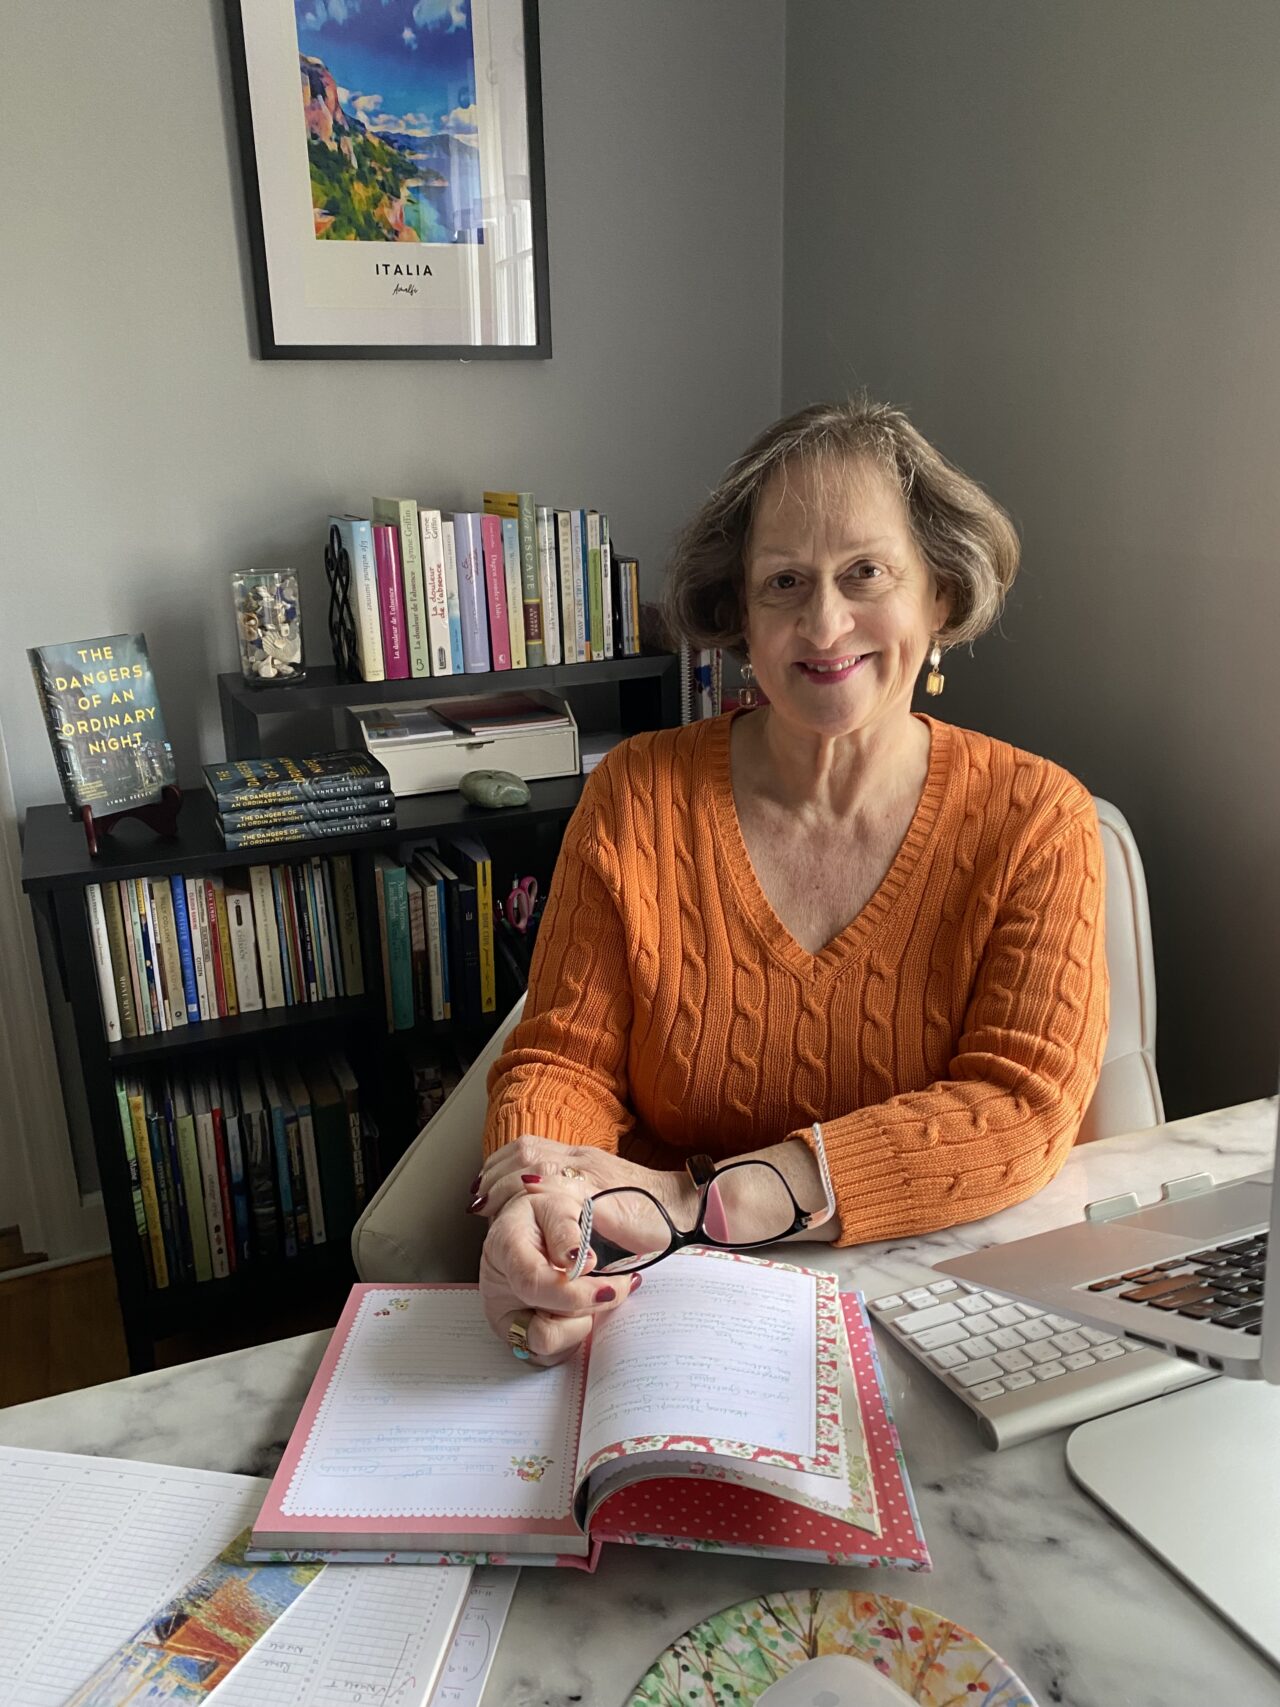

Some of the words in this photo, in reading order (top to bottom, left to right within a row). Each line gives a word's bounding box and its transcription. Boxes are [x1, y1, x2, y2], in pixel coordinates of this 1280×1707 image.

[375, 263, 433, 276] ITALIA
[403, 510, 413, 537] Griffin
[359, 540, 369, 552] life
[407, 539, 416, 564] Lynne
[362, 554, 371, 581] without
[524, 536, 535, 590] ESCAPE
[429, 567, 437, 602] douleur
[563, 556, 571, 596] ESCAPE
[409, 571, 417, 601] l'absence
[365, 584, 373, 611] summer
[411, 603, 418, 612] de
[431, 606, 438, 616] La
[438, 607, 445, 618] de
[390, 617, 397, 625] de
[412, 614, 420, 640] douleur
[391, 625, 400, 648] douleur
[78, 646, 113, 663] THE
[55, 665, 143, 691] DANGERS
[78, 694, 102, 711] OF
[111, 689, 135, 705] AN
[62, 707, 156, 737] ORDINARY
[88, 732, 142, 755] NIGHT
[216, 770, 233, 782] THE
[235, 794, 248, 802] THE
[249, 791, 278, 800] DANGERS
[313, 788, 334, 796] LYNNE
[337, 785, 362, 793] REEVES
[106, 796, 127, 806] LYNNE
[242, 799, 277, 807] ORDINARY
[255, 811, 284, 820] DANGERS
[317, 807, 339, 815] LYNNE
[248, 818, 282, 827] ORDINARY
[319, 826, 340, 834] LYNNE
[342, 823, 368, 832] REEVES
[250, 837, 284, 846] ORDINARY
[257, 830, 287, 840] DANGERS
[388, 881, 399, 919] Lindbergh
[178, 912, 187, 940] OLIVER
[120, 976, 131, 1019] MONUMENT
